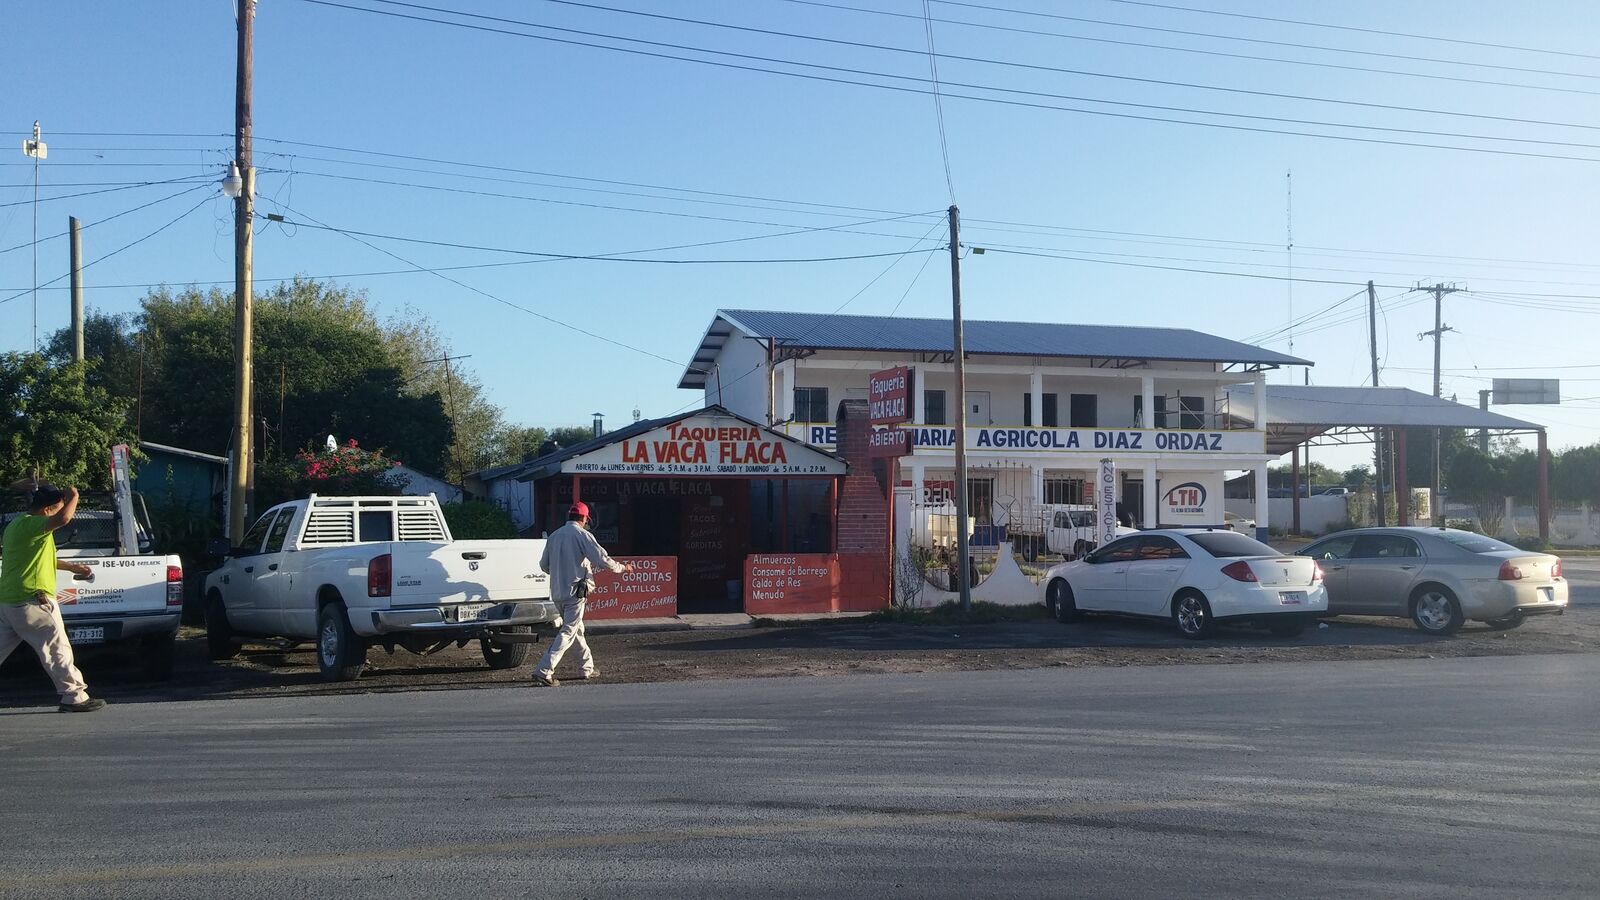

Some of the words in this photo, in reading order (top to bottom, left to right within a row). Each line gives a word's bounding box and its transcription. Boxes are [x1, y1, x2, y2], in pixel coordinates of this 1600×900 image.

[871, 370, 905, 399] Taquería
[885, 397, 905, 418] FLACA
[667, 422, 762, 442] TAQUERIA
[868, 430, 906, 447] ABIERTO
[976, 429, 1080, 448] AGRICOLA
[1094, 431, 1143, 449] DIAZ
[1155, 432, 1223, 450] ORDAZ
[622, 441, 650, 464] LA
[653, 441, 708, 464] VACA
[719, 441, 788, 465] FLACA
[631, 464, 655, 472] VIERNES
[668, 464, 672, 472] 5
[783, 465, 787, 473] 5
[809, 465, 814, 473] 2
[1103, 466, 1114, 483] NO
[1168, 489, 1198, 506] LTH
[1103, 486, 1114, 543] ESTACIO
[753, 554, 796, 565] Almuerzos
[622, 571, 672, 583] GORDITAS
[752, 566, 785, 577] Consome
[788, 567, 796, 576] de
[797, 565, 828, 578] Borrego
[613, 581, 661, 593] PLATILLOS
[752, 578, 772, 588] Caldo
[776, 578, 785, 588] de
[787, 577, 801, 587] Res
[77, 587, 124, 595] Champion
[752, 589, 785, 600] Menudo
[595, 597, 618, 610] ASADA
